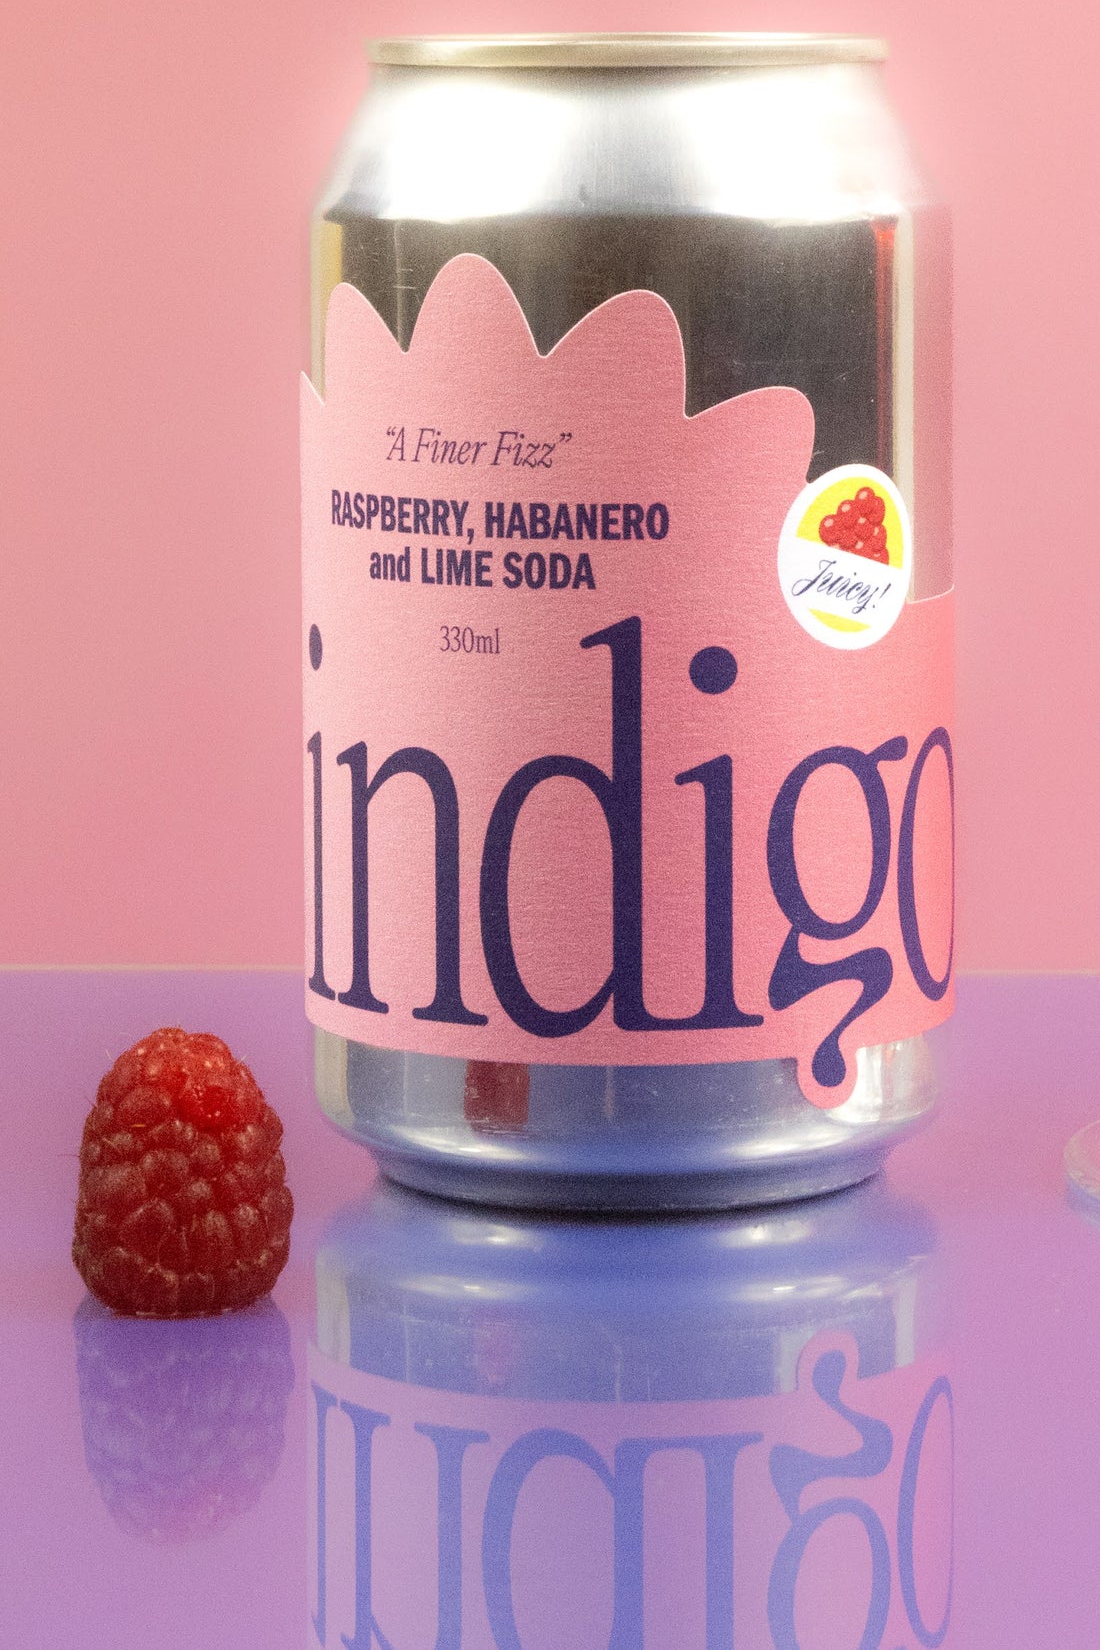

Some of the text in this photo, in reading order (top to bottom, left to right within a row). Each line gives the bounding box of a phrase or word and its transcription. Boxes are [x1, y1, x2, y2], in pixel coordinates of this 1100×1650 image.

[411, 428, 488, 466] Finer
[490, 431, 573, 469] Fizz”
[331, 490, 670, 544] RASPBERRY, HABANERO
[369, 547, 596, 590] and LIME SODA
[793, 560, 892, 614] Juicy!
[438, 626, 501, 654] 330ml
[308, 616, 954, 1087] indigo
